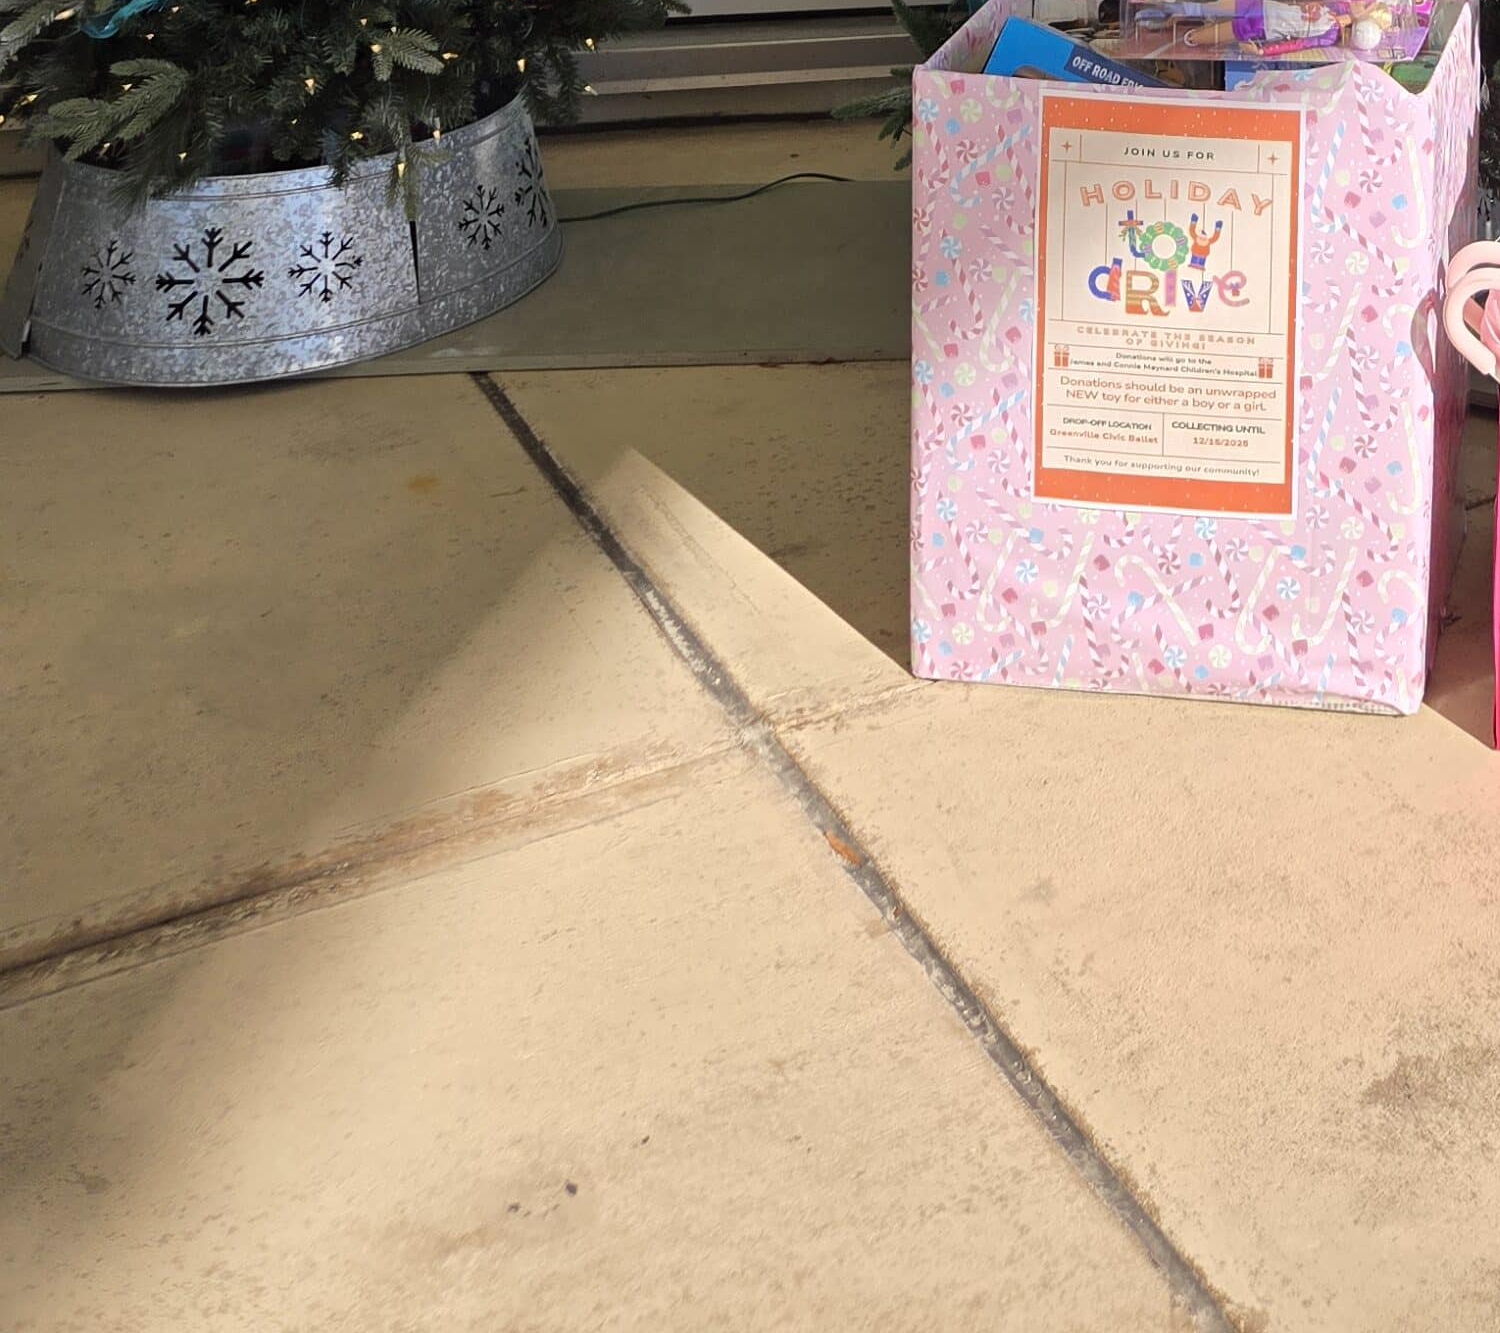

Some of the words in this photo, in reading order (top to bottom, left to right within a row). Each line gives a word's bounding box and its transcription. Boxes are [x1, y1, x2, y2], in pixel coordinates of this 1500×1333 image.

[1072, 56, 1093, 72] OFF
[1091, 64, 1121, 84] ROAD
[1123, 147, 1155, 157] JOIN
[1162, 149, 1180, 158] US
[1187, 151, 1215, 160] FOR
[1079, 179, 1273, 216] HOLIDAY
[1077, 325, 1158, 339] CELEBRATE
[1164, 332, 1191, 341] THE
[1199, 334, 1255, 345] SEASON
[1126, 337, 1143, 346] OF
[1115, 352, 1157, 362] Donations
[1159, 354, 1174, 362] will
[1113, 361, 1141, 369] Connie
[1143, 363, 1179, 372] Maynard
[1180, 364, 1221, 374] Children's
[1223, 369, 1257, 378] Hospital
[1060, 375, 1122, 389] Donations
[1125, 381, 1166, 392] should
[1169, 383, 1184, 393] be
[1187, 386, 1202, 395] an
[1205, 388, 1277, 400] unwrapped
[1066, 389, 1099, 400] NEW
[1102, 393, 1121, 404] toy
[1124, 393, 1141, 403] for
[1143, 395, 1179, 406] either
[1181, 399, 1189, 407] a
[1192, 398, 1214, 410] boy
[1217, 401, 1229, 409] or
[1063, 417, 1107, 427] DROP-OFF
[1108, 420, 1152, 431] LOCATION
[1171, 421, 1233, 433] COLLECTING
[1235, 424, 1266, 434] UNTIL
[1049, 428, 1100, 439] Greenville
[1102, 432, 1126, 442] Civic
[1128, 434, 1158, 444] Ballet
[1063, 454, 1093, 464] Thank
[1095, 458, 1112, 466] you
[1114, 459, 1128, 468] for
[1131, 462, 1182, 472] supporting
[1203, 467, 1260, 477] community!
